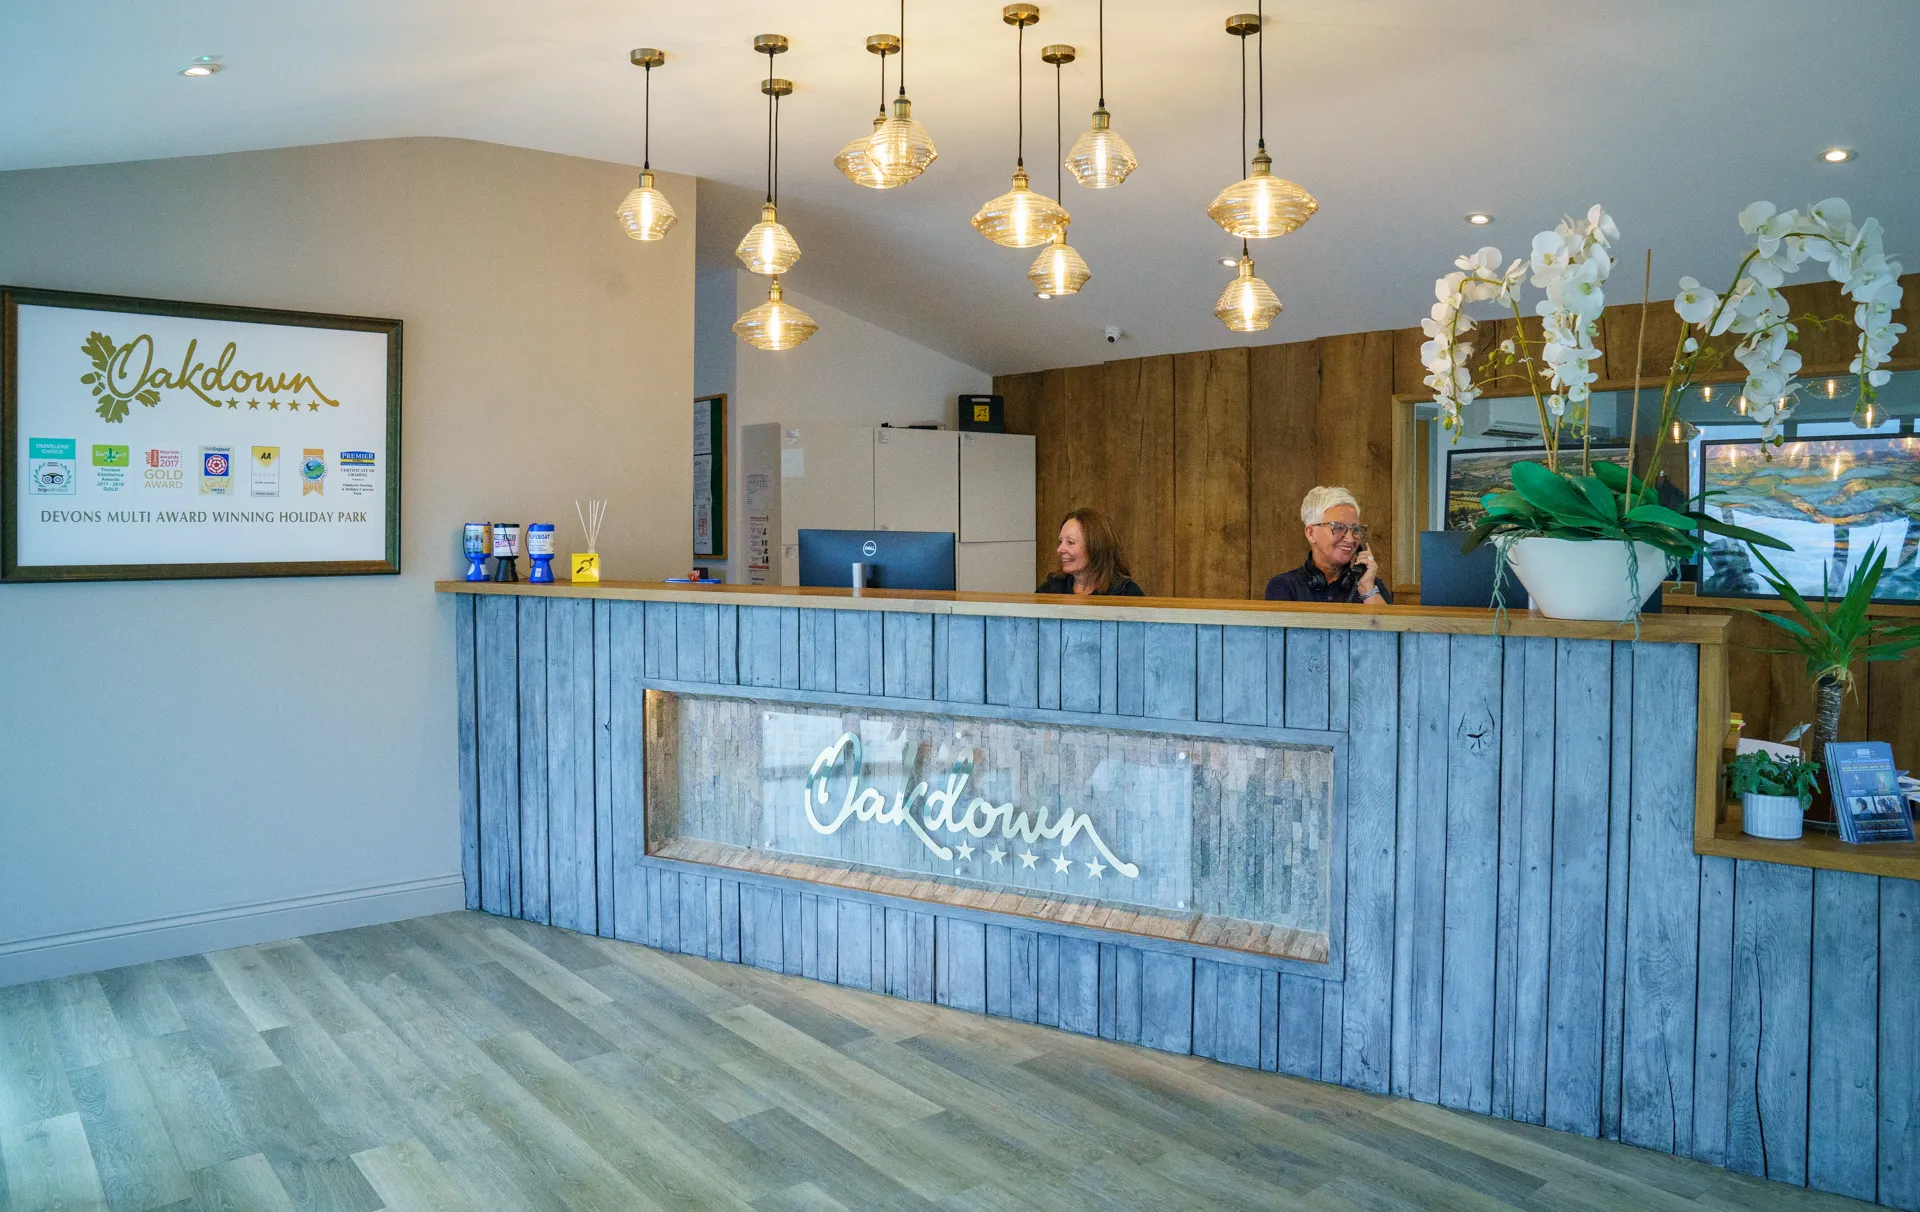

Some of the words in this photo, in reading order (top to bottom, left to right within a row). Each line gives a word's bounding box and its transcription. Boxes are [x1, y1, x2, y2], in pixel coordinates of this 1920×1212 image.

[107, 333, 340, 408] Oakdown
[260, 452, 271, 460] AA
[342, 452, 374, 460] PREMIER
[144, 469, 183, 480] GOLD
[144, 480, 183, 489] AWARD
[201, 478, 231, 493] Gold
[41, 510, 102, 523] DEVONS
[107, 511, 150, 523] MULTI
[156, 511, 207, 523] AWARD
[212, 511, 274, 523] WINNING
[279, 511, 334, 523] HOLIDAY
[338, 511, 367, 522] PARK
[804, 731, 1140, 878] Oakdown
